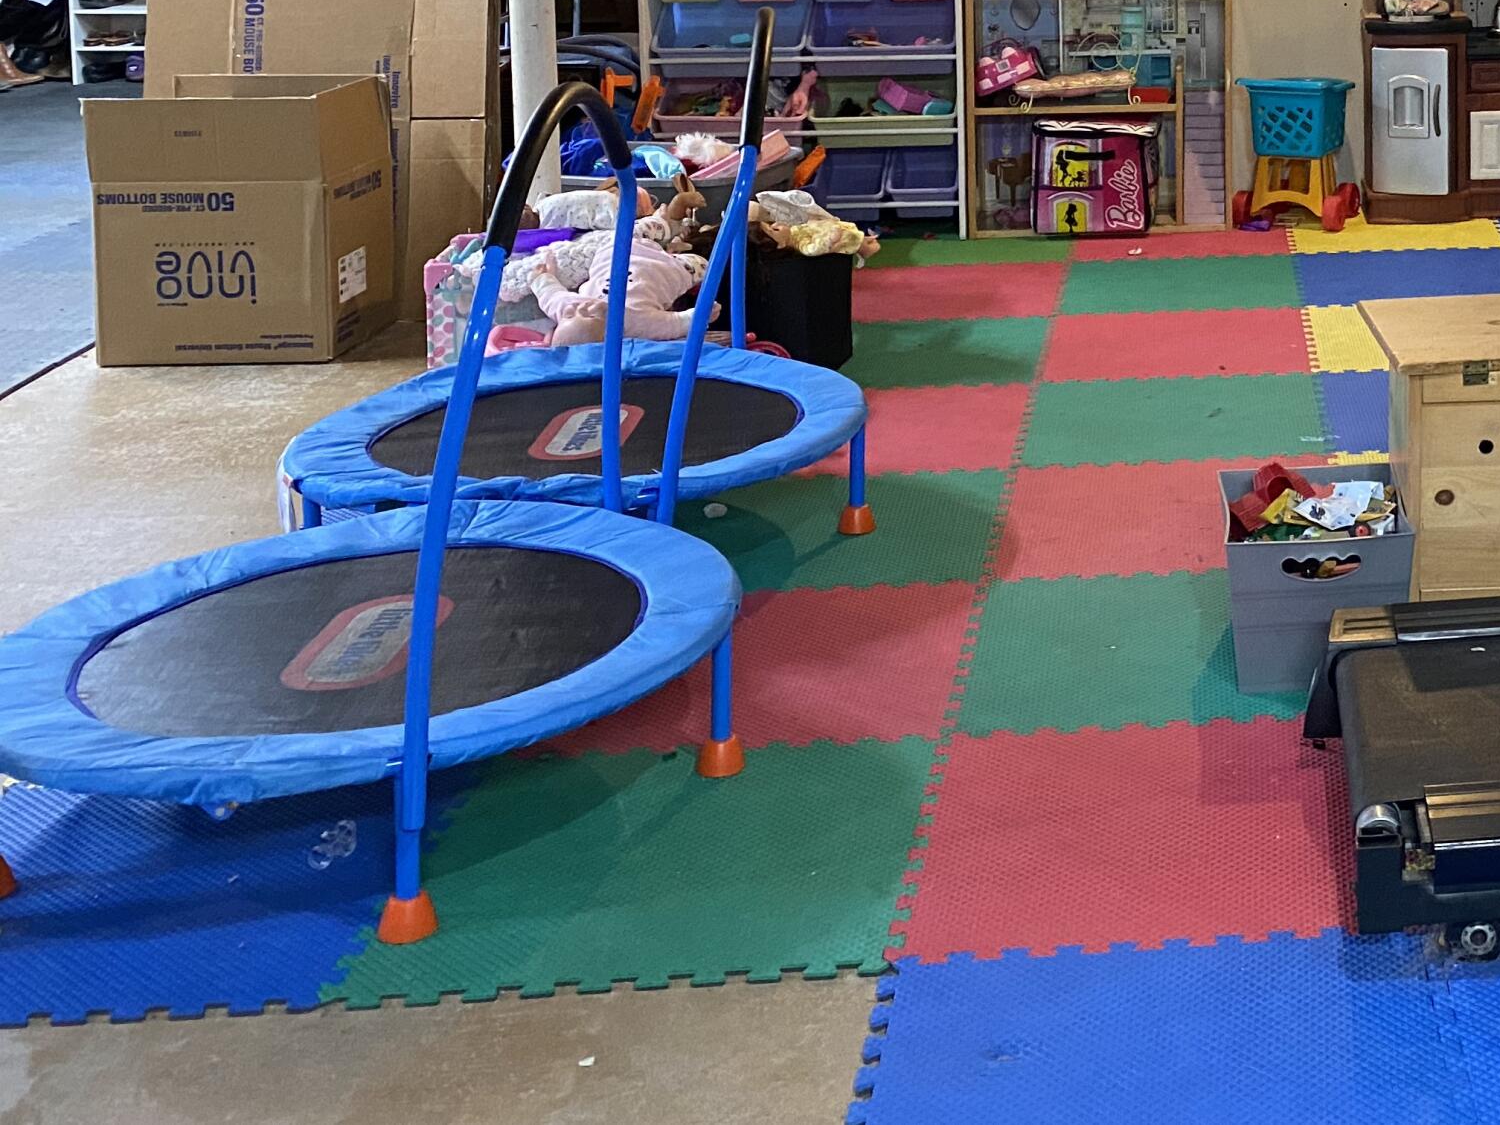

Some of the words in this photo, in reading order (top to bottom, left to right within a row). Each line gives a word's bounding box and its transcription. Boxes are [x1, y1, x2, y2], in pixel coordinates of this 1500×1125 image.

[243, 18, 255, 55] MOUSE
[243, 58, 254, 74] BO
[97, 193, 157, 205] BOTTOMS
[160, 192, 204, 204] MOUSE
[207, 192, 235, 212] 50
[1106, 159, 1142, 229] Barbie
